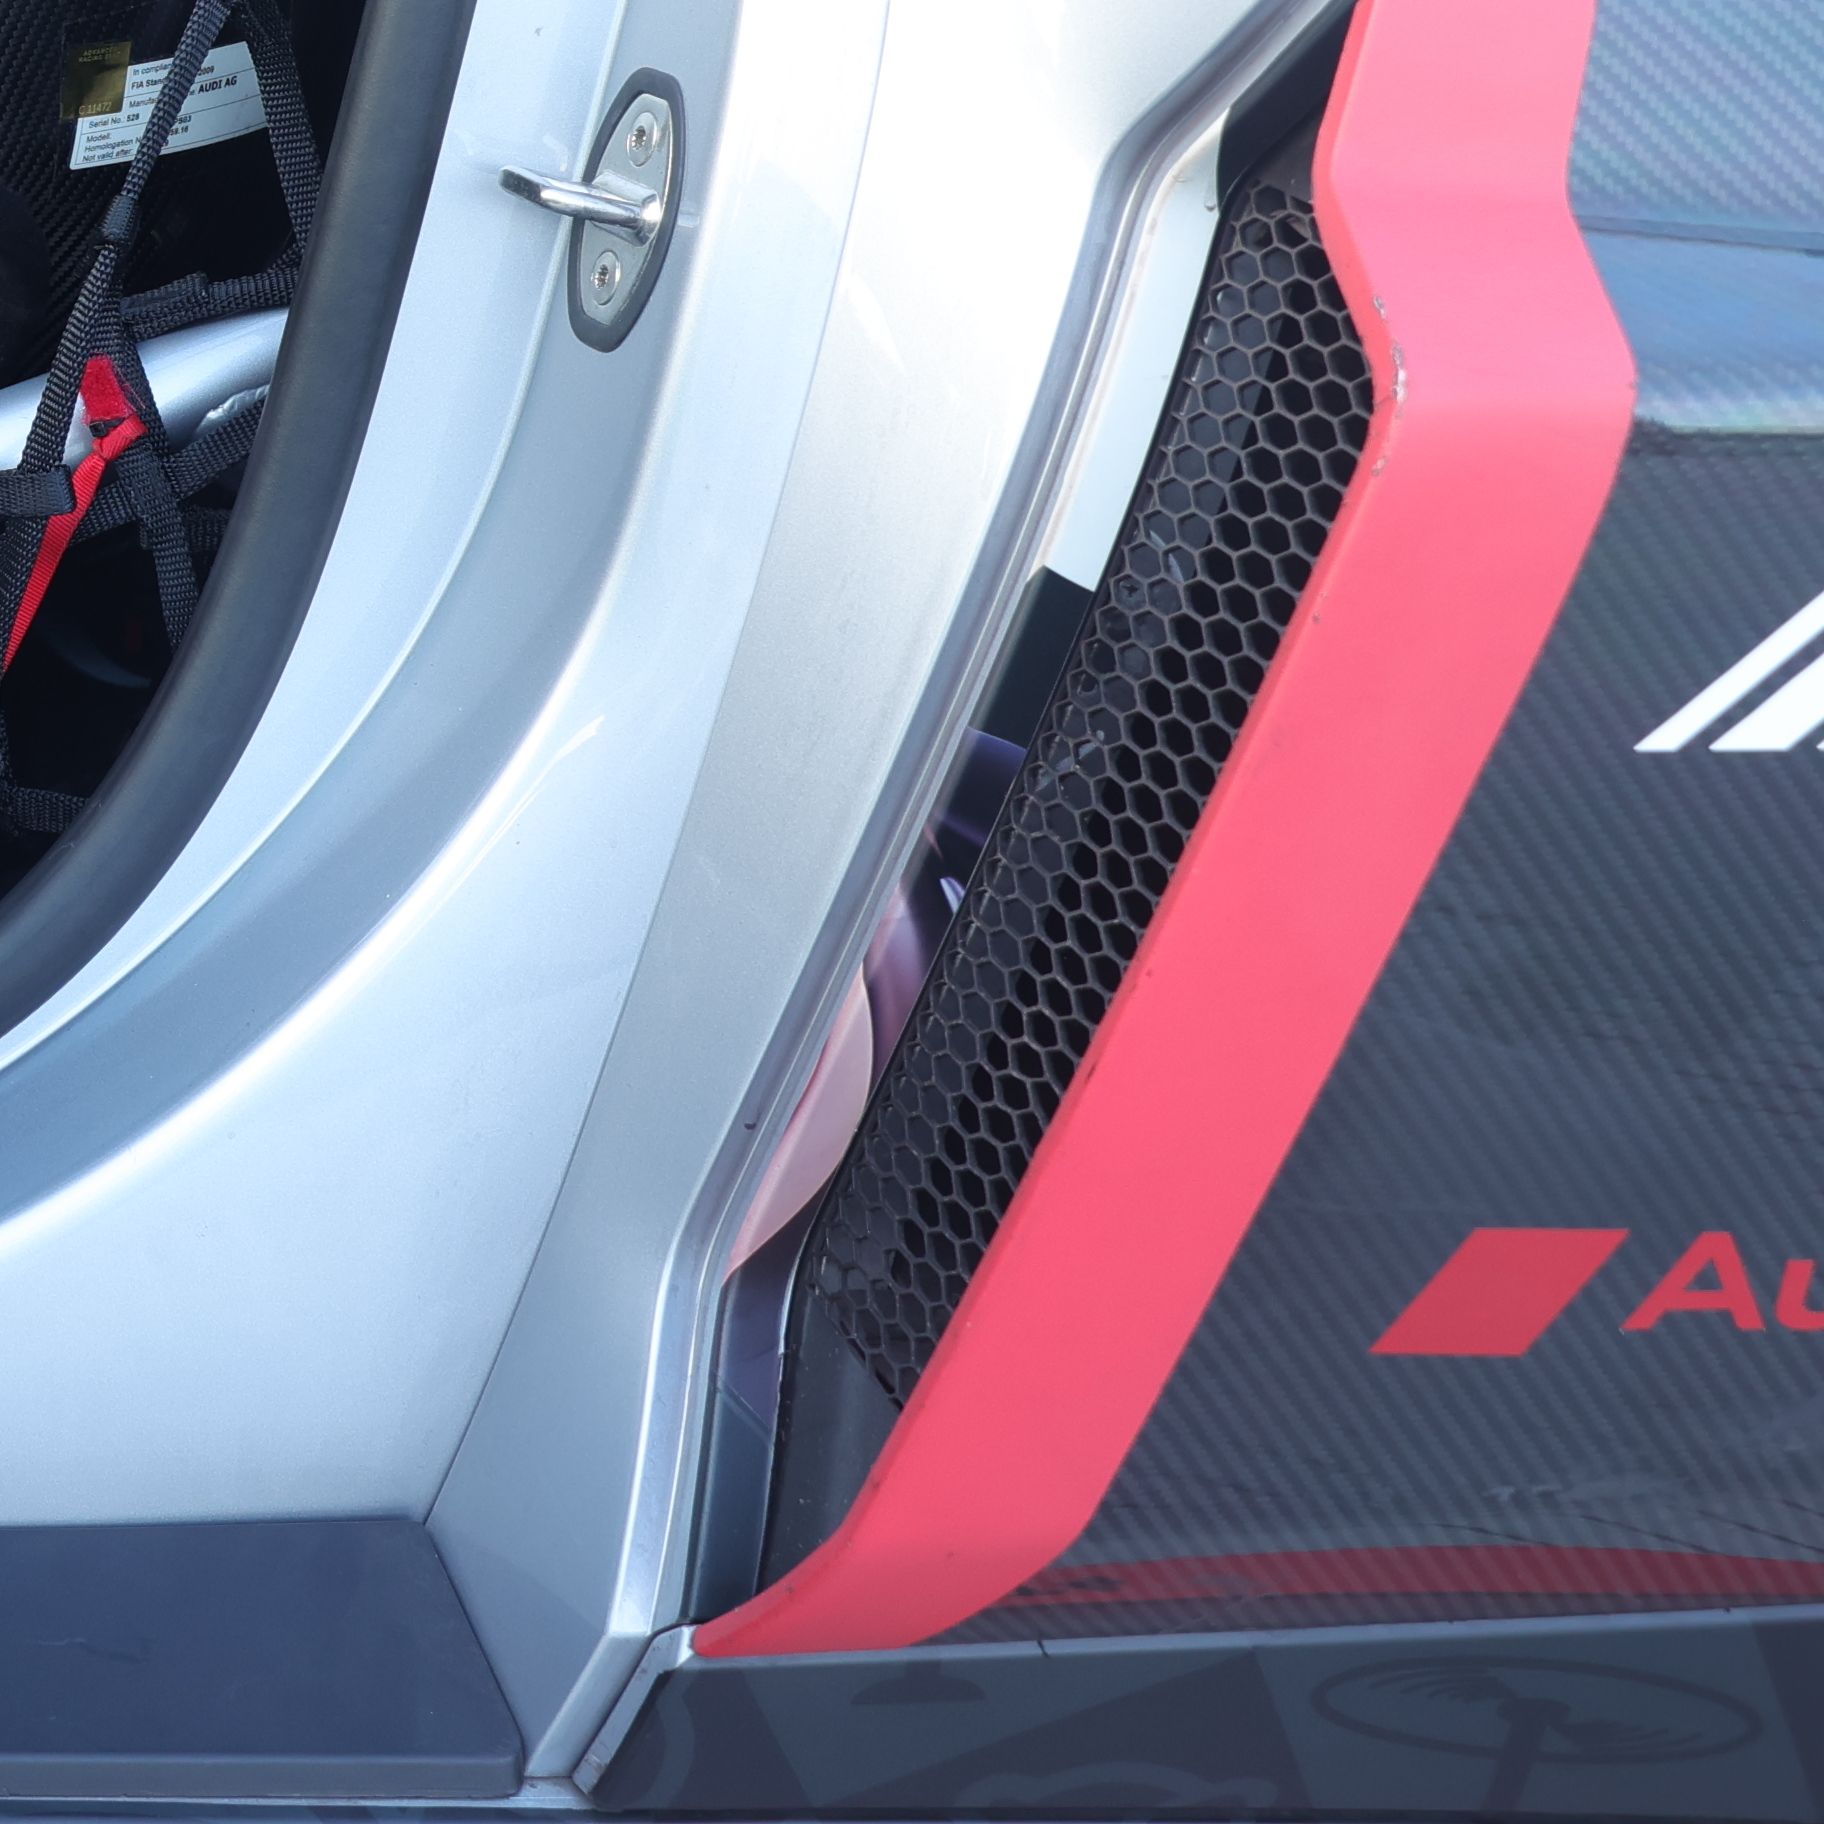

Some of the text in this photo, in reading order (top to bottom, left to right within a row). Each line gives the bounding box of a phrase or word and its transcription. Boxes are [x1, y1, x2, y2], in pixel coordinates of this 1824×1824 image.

[131, 80, 145, 90] FIA
[146, 76, 167, 88] Stan
[198, 79, 222, 95] AUDI
[224, 75, 238, 88] AG
[88, 118, 110, 129] Serial
[84, 137, 134, 153] Homologation
[82, 153, 96, 163] Not
[97, 150, 114, 161] valid
